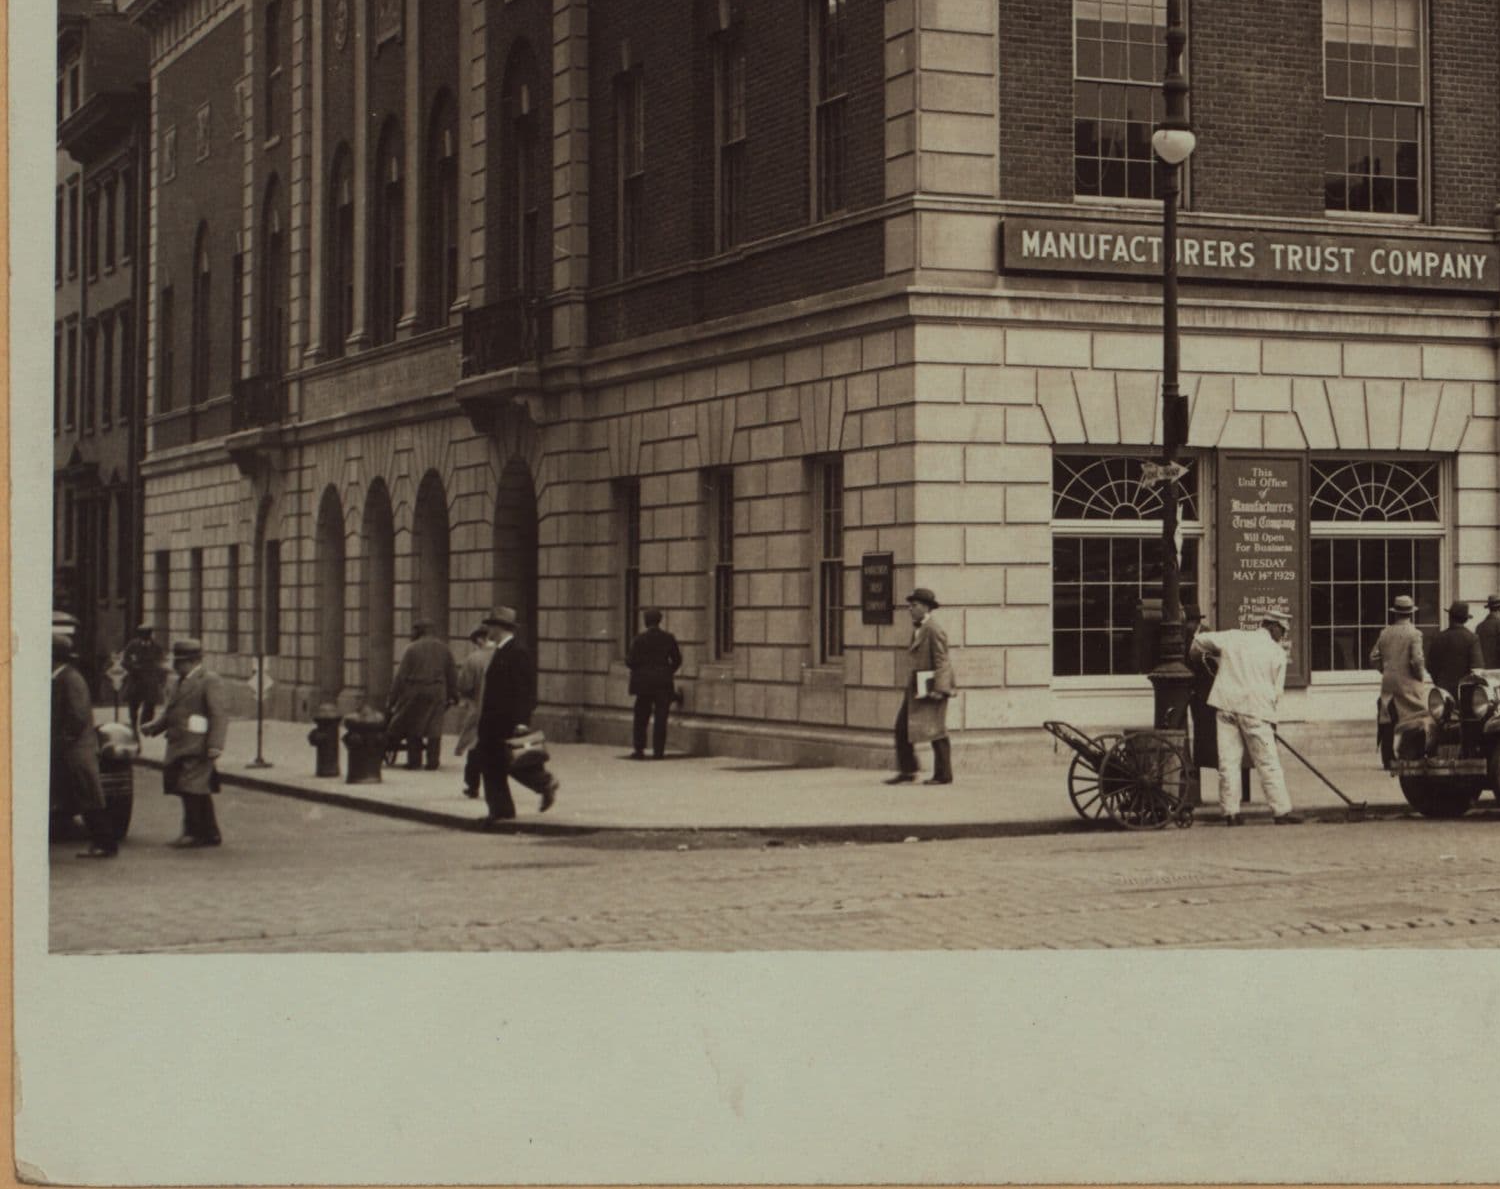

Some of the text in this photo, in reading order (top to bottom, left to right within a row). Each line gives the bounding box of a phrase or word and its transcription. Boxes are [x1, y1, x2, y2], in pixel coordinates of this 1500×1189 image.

[1022, 229, 1487, 280] MANUFACTRERS TRUST COMPANY
[1252, 467, 1272, 477] This
[1238, 477, 1288, 487] Unit Office
[1244, 532, 1285, 543] Will Open
[1236, 543, 1293, 552] For Business
[1240, 558, 1287, 568] TUESDAY
[1233, 570, 1256, 580] MAY
[1273, 570, 1295, 580] 1929
